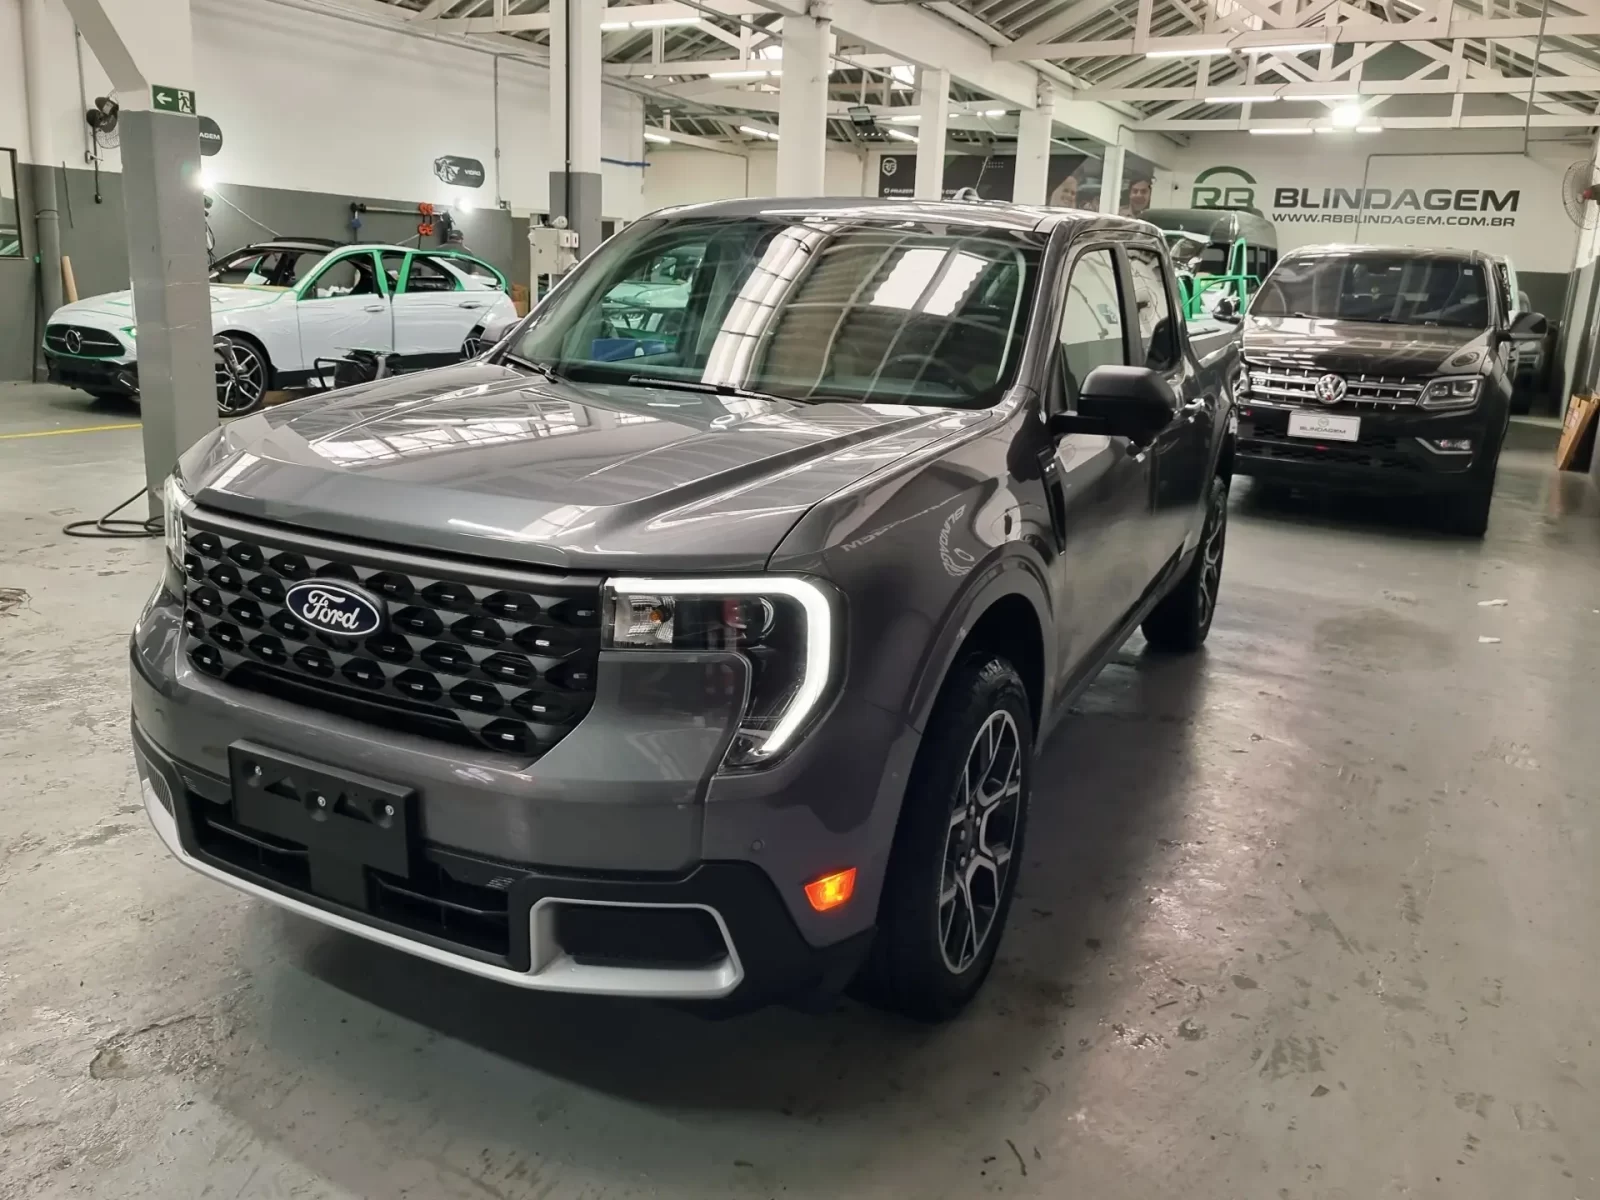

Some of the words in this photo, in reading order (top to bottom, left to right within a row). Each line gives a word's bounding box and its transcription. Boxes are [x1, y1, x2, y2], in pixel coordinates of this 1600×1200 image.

[1273, 187, 1520, 212] BLINDAGEM
[1272, 213, 1516, 227] WWW.RBBLINDAGEM.COM.BR
[302, 590, 360, 630] Ford
